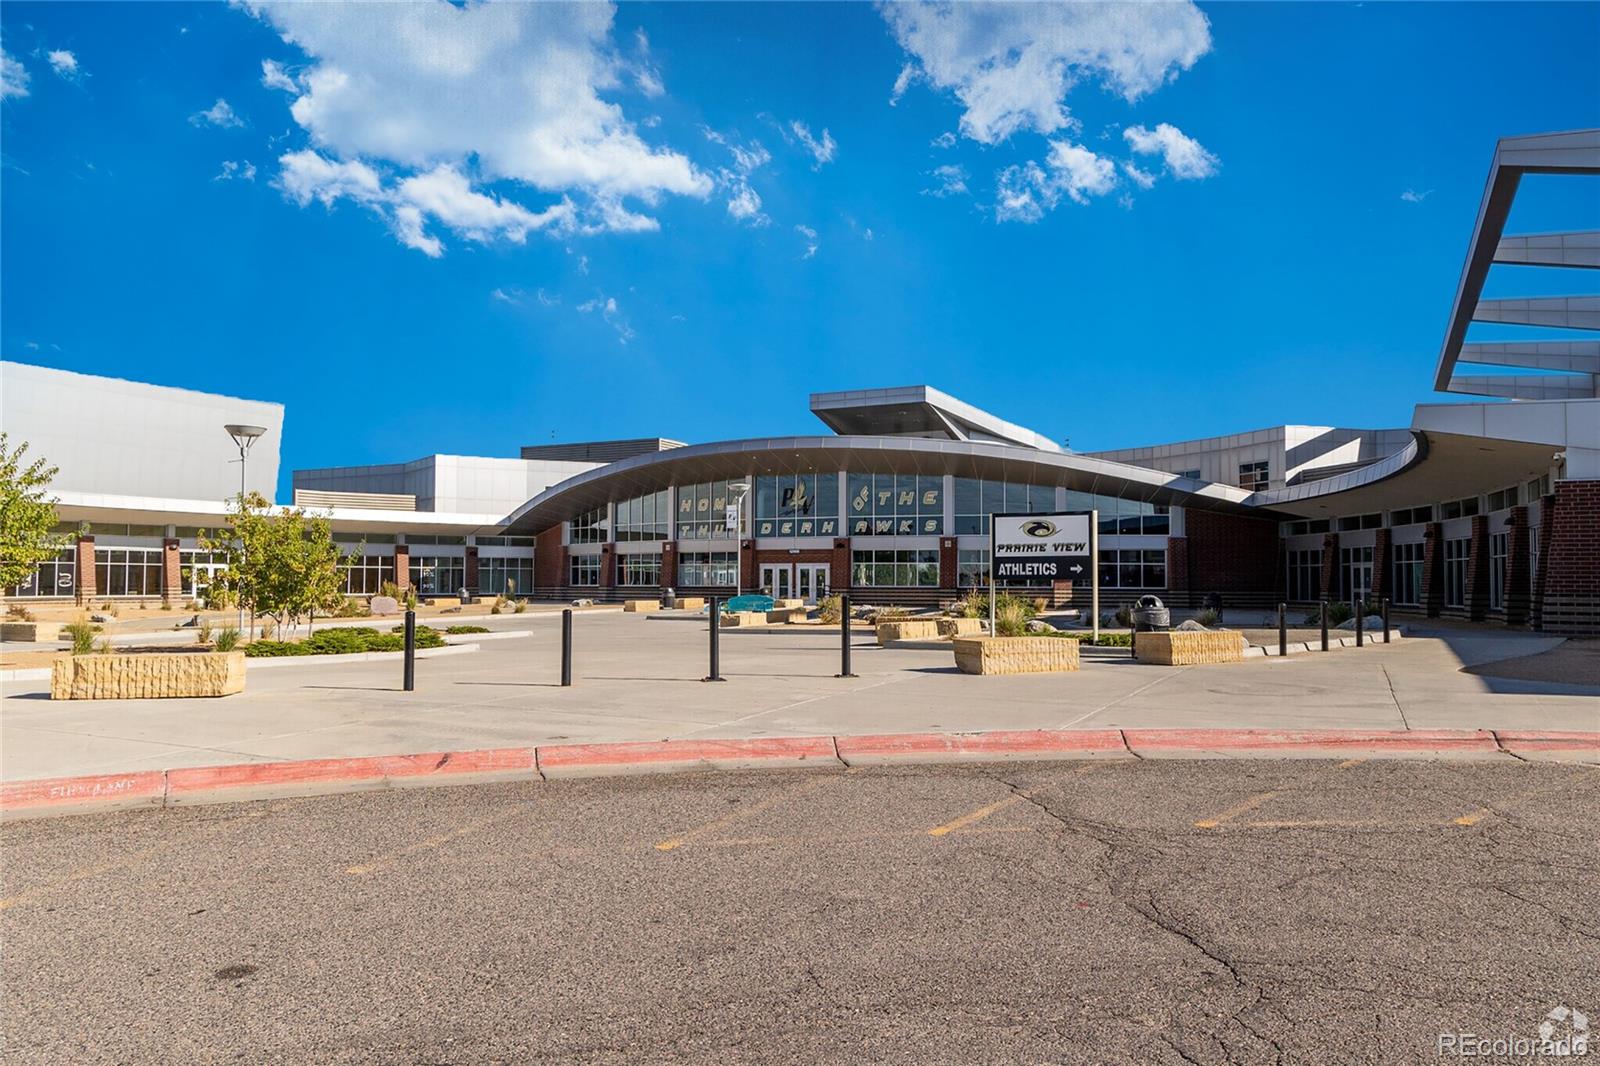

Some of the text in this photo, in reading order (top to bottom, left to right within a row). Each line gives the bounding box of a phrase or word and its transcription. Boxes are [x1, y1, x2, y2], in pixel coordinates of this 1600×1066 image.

[680, 485, 939, 513] HOM OF THE
[996, 542, 1087, 553] PRAIRIE VIEW
[998, 562, 1057, 576] ATHLETICS
